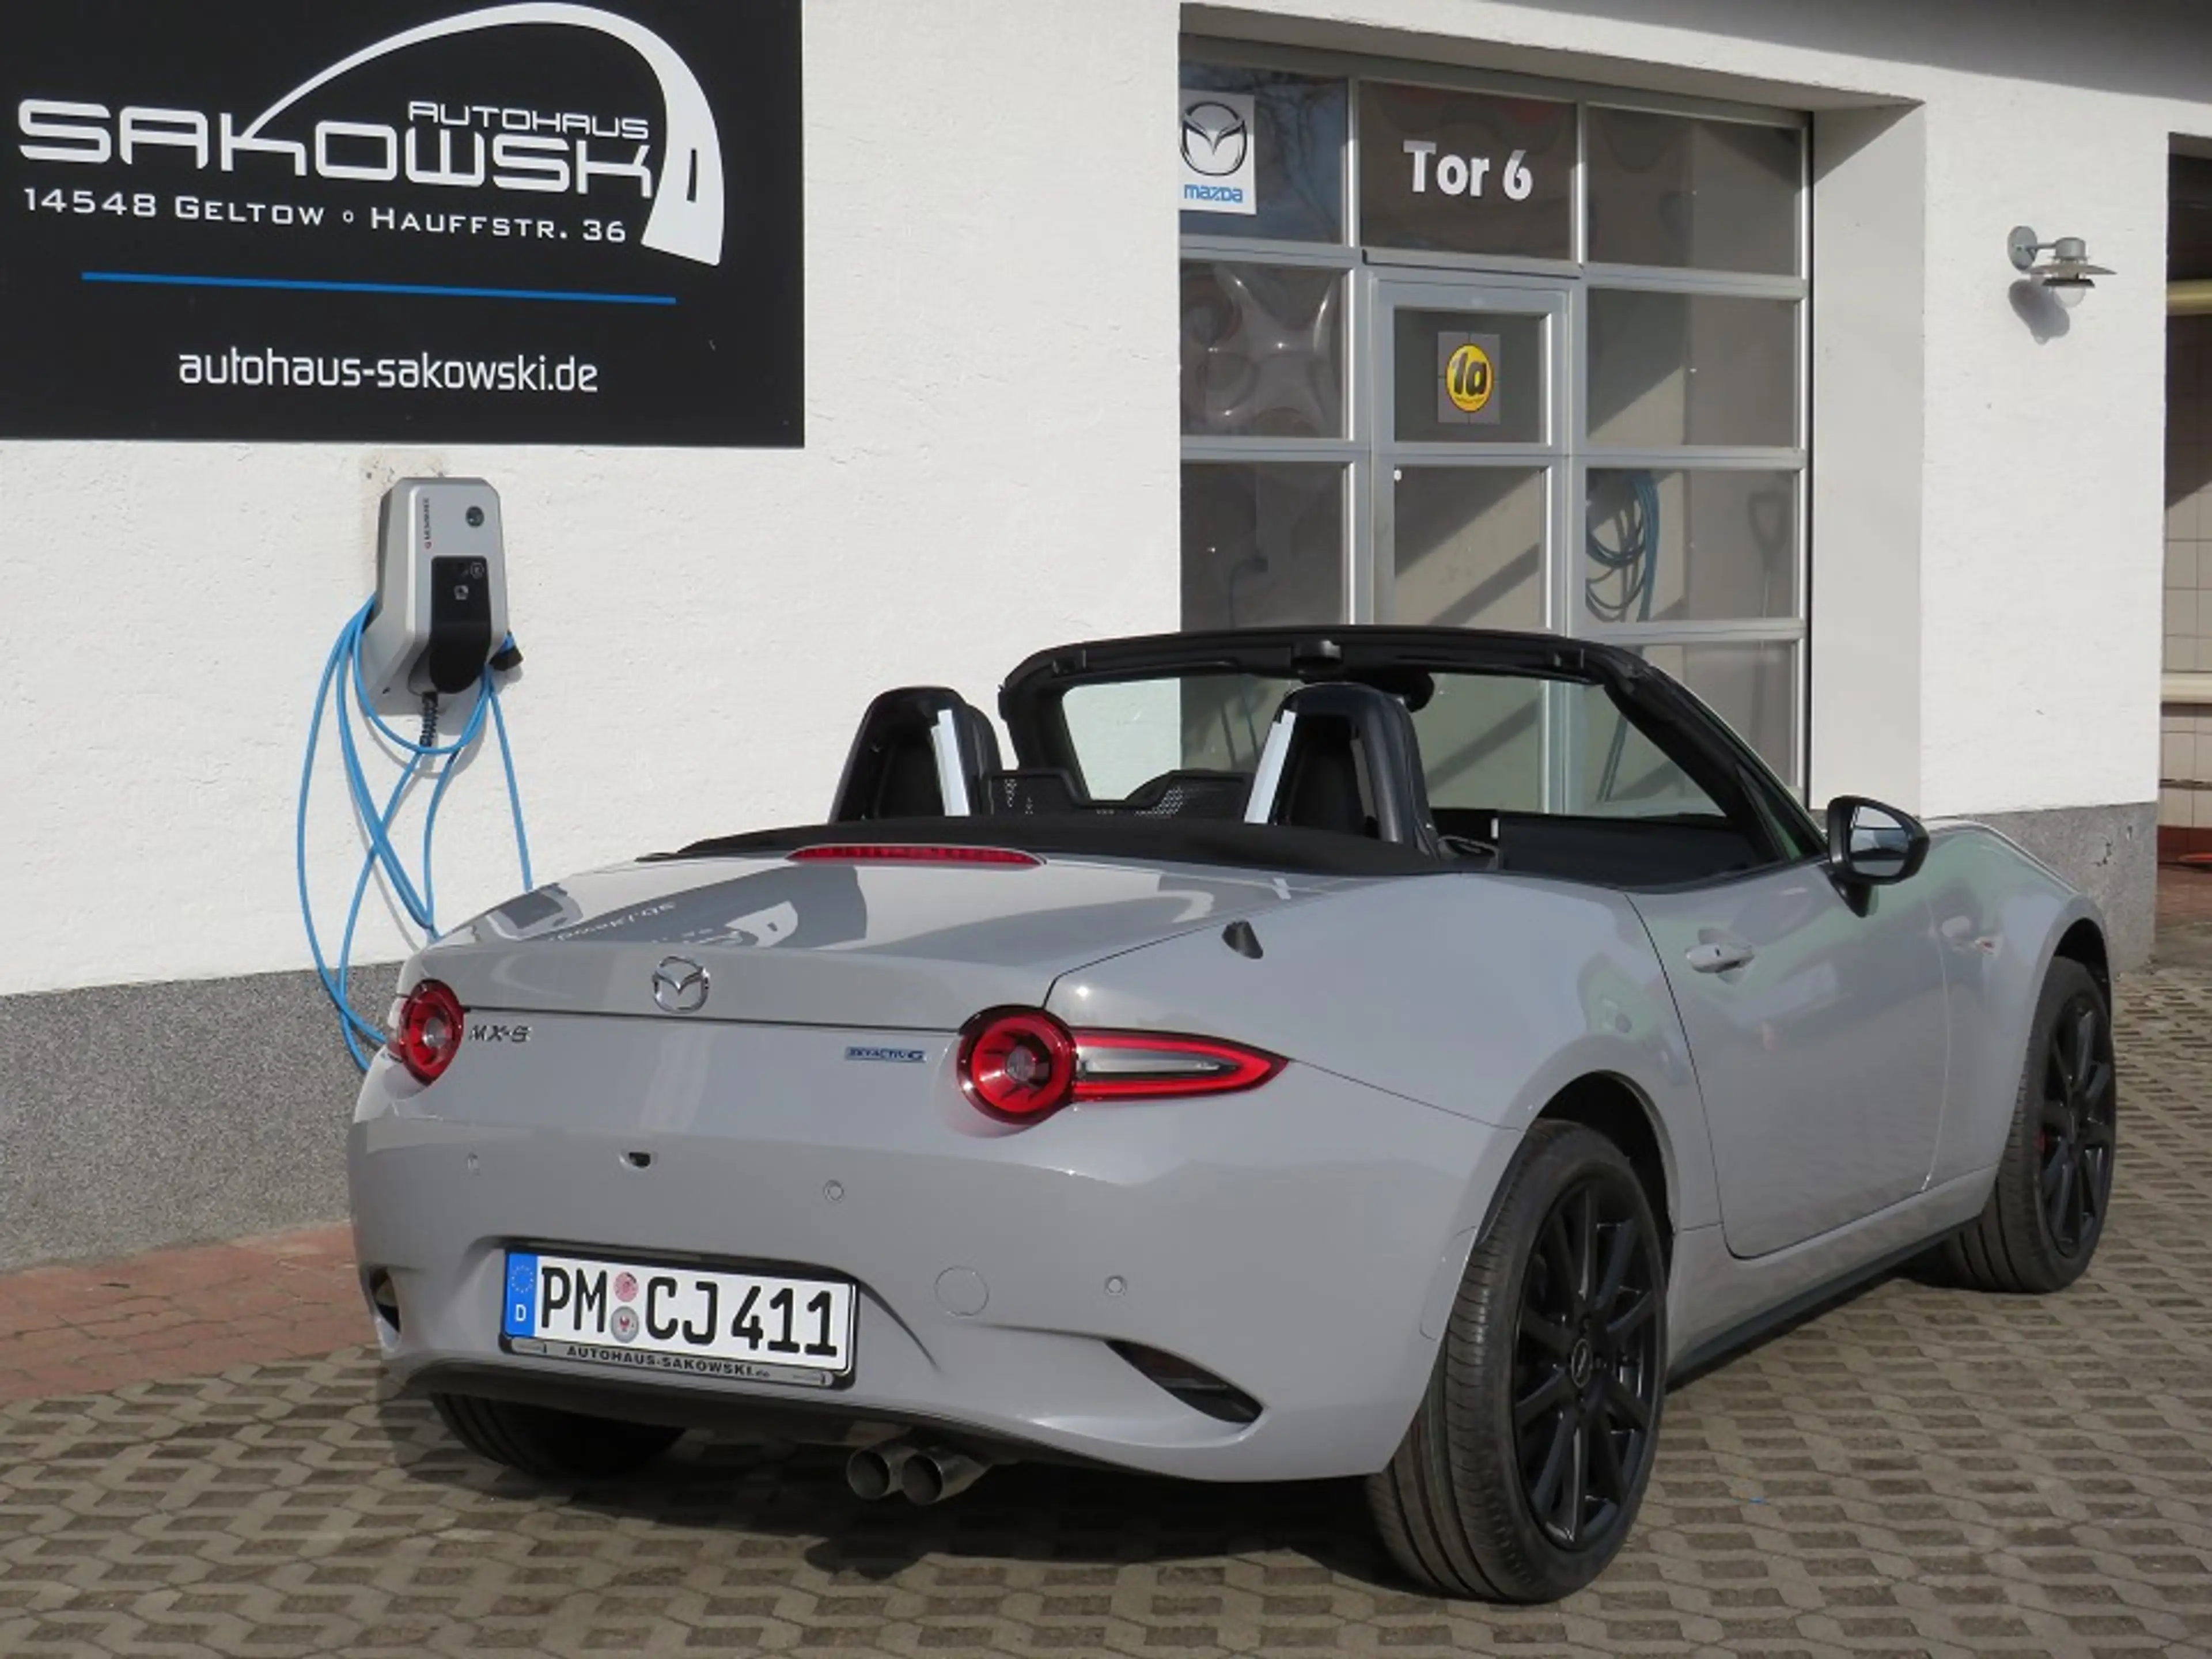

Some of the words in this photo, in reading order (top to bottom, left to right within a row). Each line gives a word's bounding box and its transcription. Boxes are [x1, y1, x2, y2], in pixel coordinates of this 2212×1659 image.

[408, 101, 649, 139] AUTOHAUS
[1404, 141, 1490, 196] Tor
[1503, 150, 1533, 201] 6
[24, 188, 156, 217] 14548
[582, 219, 626, 243] 36
[179, 346, 598, 392] autohaus-sakowski.de
[468, 1024, 531, 1043] MX-5
[515, 1304, 527, 1321] D
[541, 1267, 607, 1332] PM
[646, 1277, 719, 1344] CJ
[731, 1285, 838, 1357] 411
